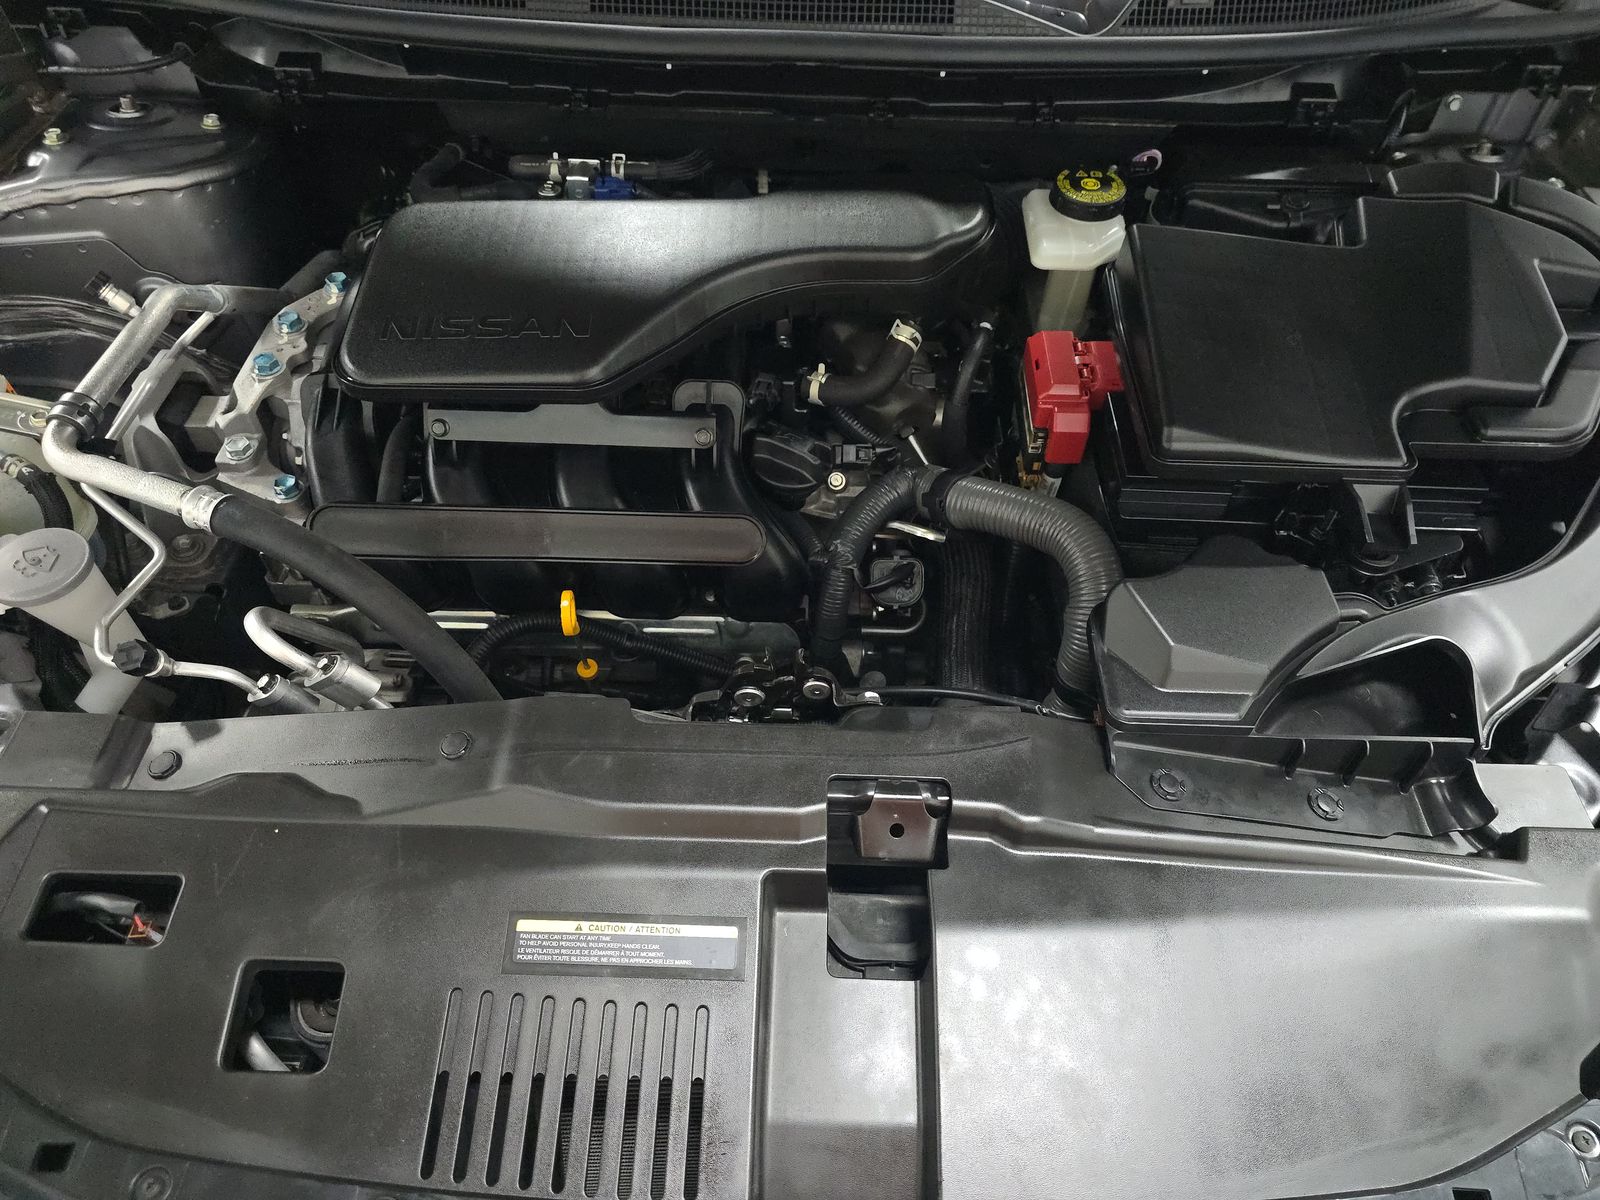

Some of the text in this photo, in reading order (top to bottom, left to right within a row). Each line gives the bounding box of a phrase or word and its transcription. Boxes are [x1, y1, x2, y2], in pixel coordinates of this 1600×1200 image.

[379, 315, 592, 340] NISSAN
[588, 924, 625, 932] CAUTION
[635, 926, 681, 934] ATTENTION
[560, 948, 581, 956] RISQUE
[591, 949, 620, 957] DÉMARRER
[533, 954, 552, 962] ÉVITER
